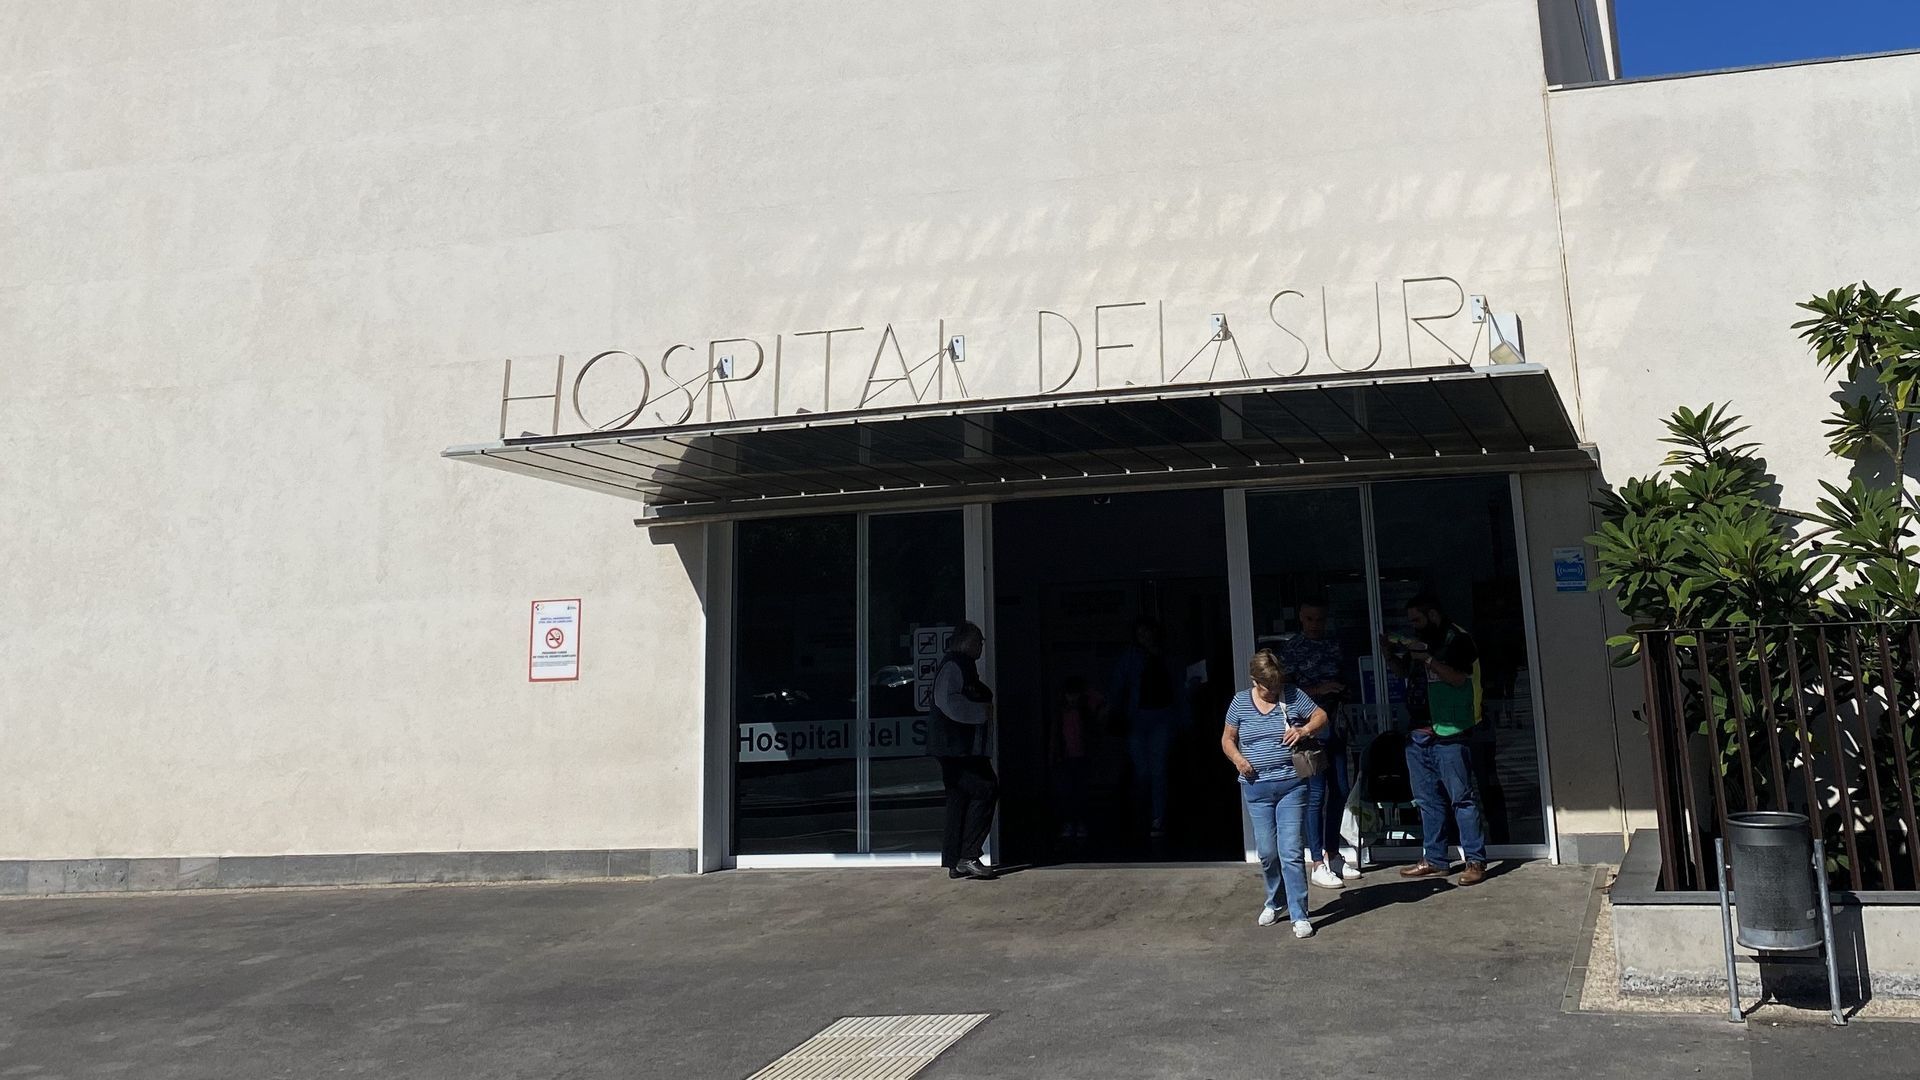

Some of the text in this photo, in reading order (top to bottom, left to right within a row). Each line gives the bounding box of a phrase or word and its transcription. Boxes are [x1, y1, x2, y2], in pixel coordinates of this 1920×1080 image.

[501, 276, 1472, 438] HOSPITAL DEL SUR
[737, 722, 849, 757] Hospital
